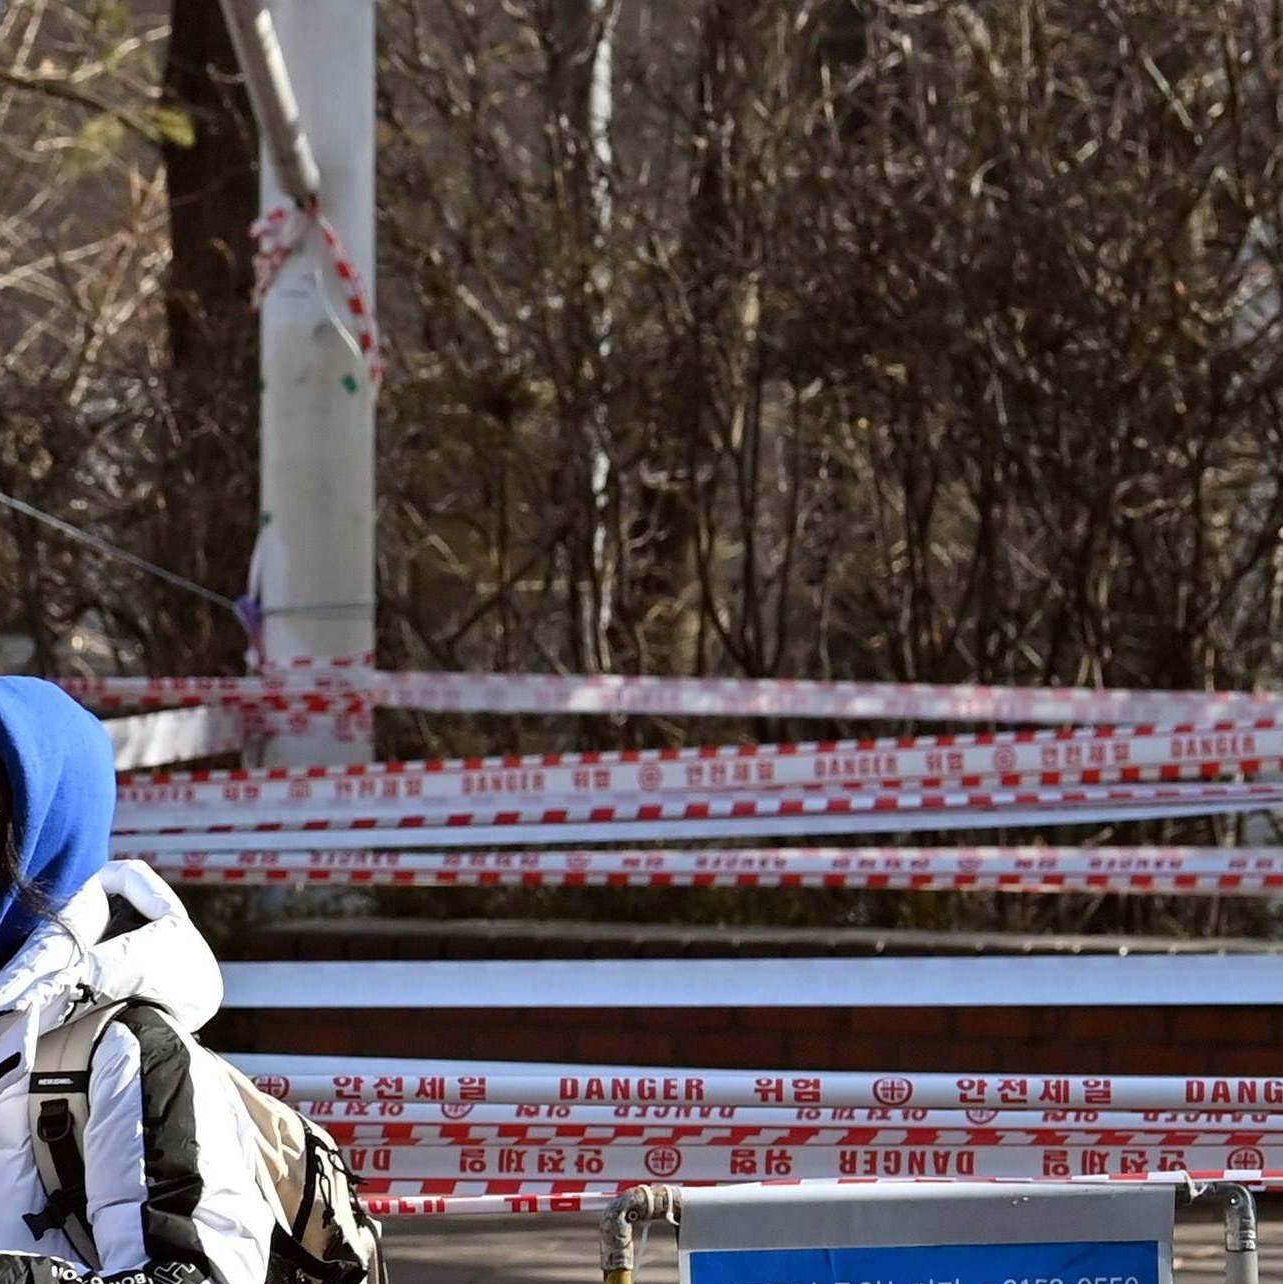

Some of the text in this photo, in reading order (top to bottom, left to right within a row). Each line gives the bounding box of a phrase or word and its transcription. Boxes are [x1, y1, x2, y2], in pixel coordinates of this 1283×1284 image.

[560, 1078, 704, 1100] DANGER
[755, 1078, 820, 1102] 위험
[956, 1079, 1112, 1104] 안전제일
[1185, 1079, 1283, 1103] DANG
[459, 1147, 603, 1175] 안전제일
[731, 1150, 792, 1175] 위험
[840, 1150, 975, 1175] DANGER
